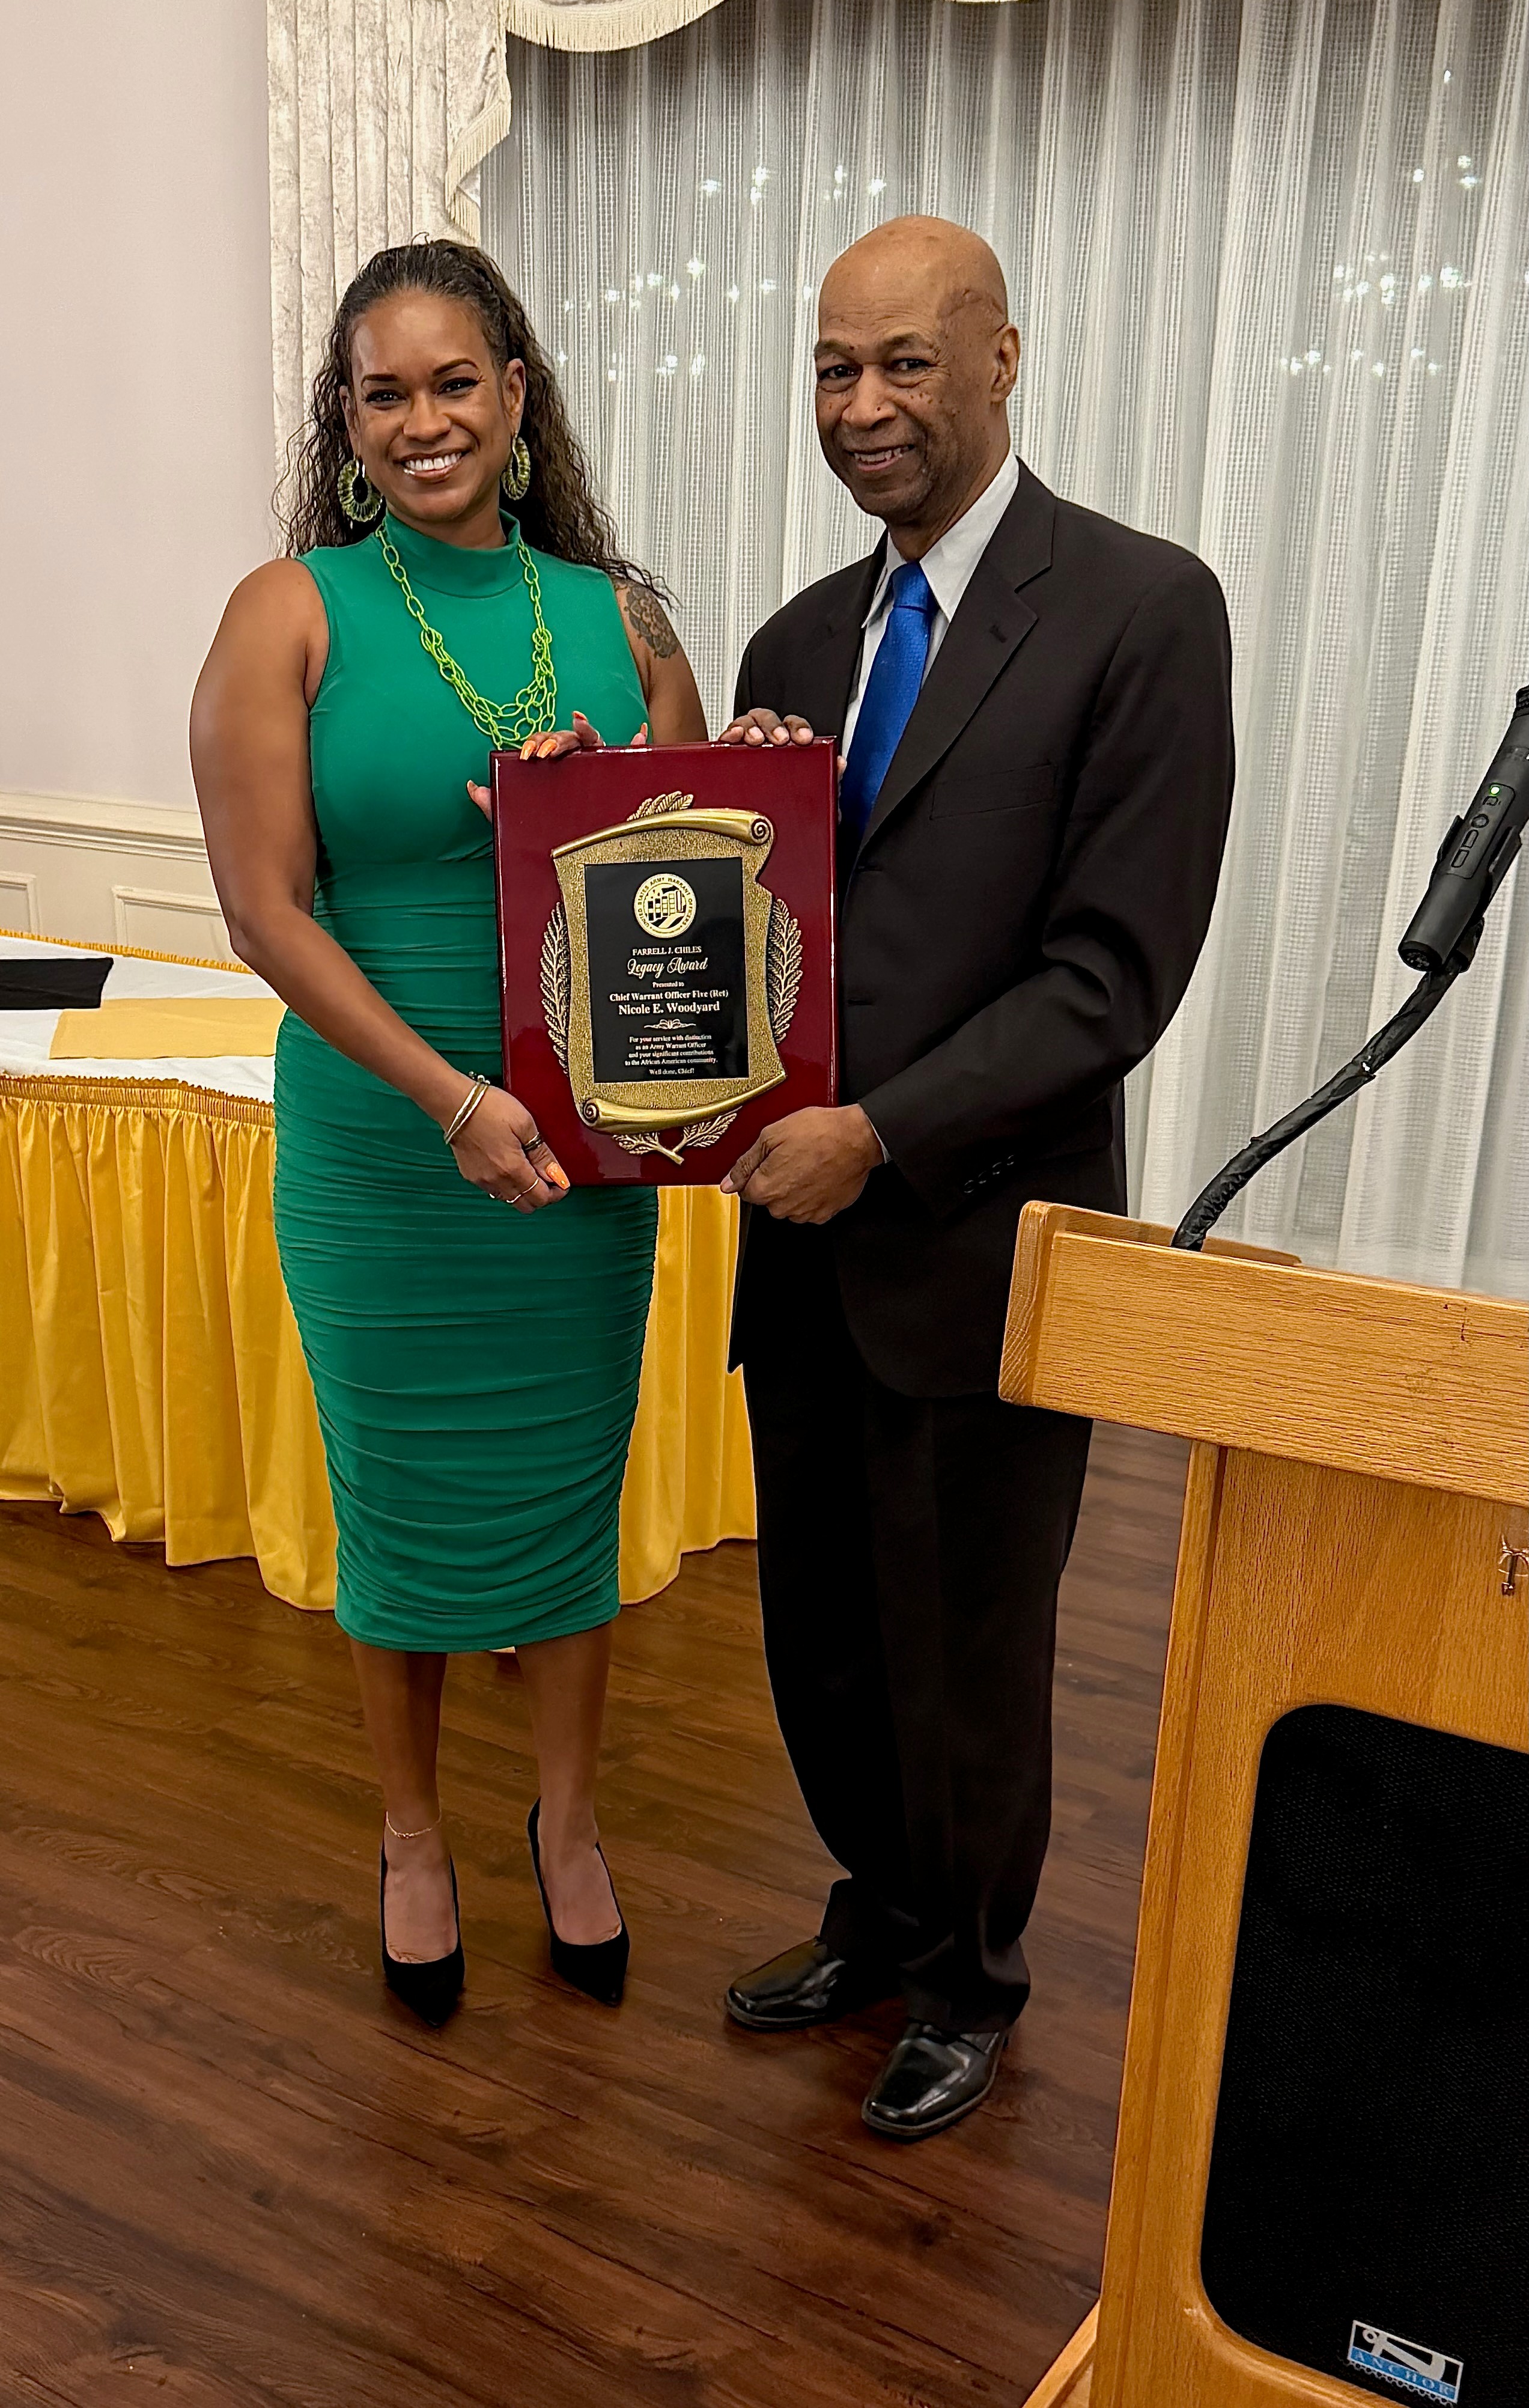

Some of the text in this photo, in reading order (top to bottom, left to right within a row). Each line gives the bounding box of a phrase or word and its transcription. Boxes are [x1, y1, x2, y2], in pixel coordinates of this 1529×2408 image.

[627, 957, 708, 980] Legacy Award
[609, 989, 729, 1001] Chief Warrant Officer Five (Ret)
[618, 1001, 720, 1015] Nicole E. Woodyard
[1355, 2352, 1451, 2395] ANCHOR
